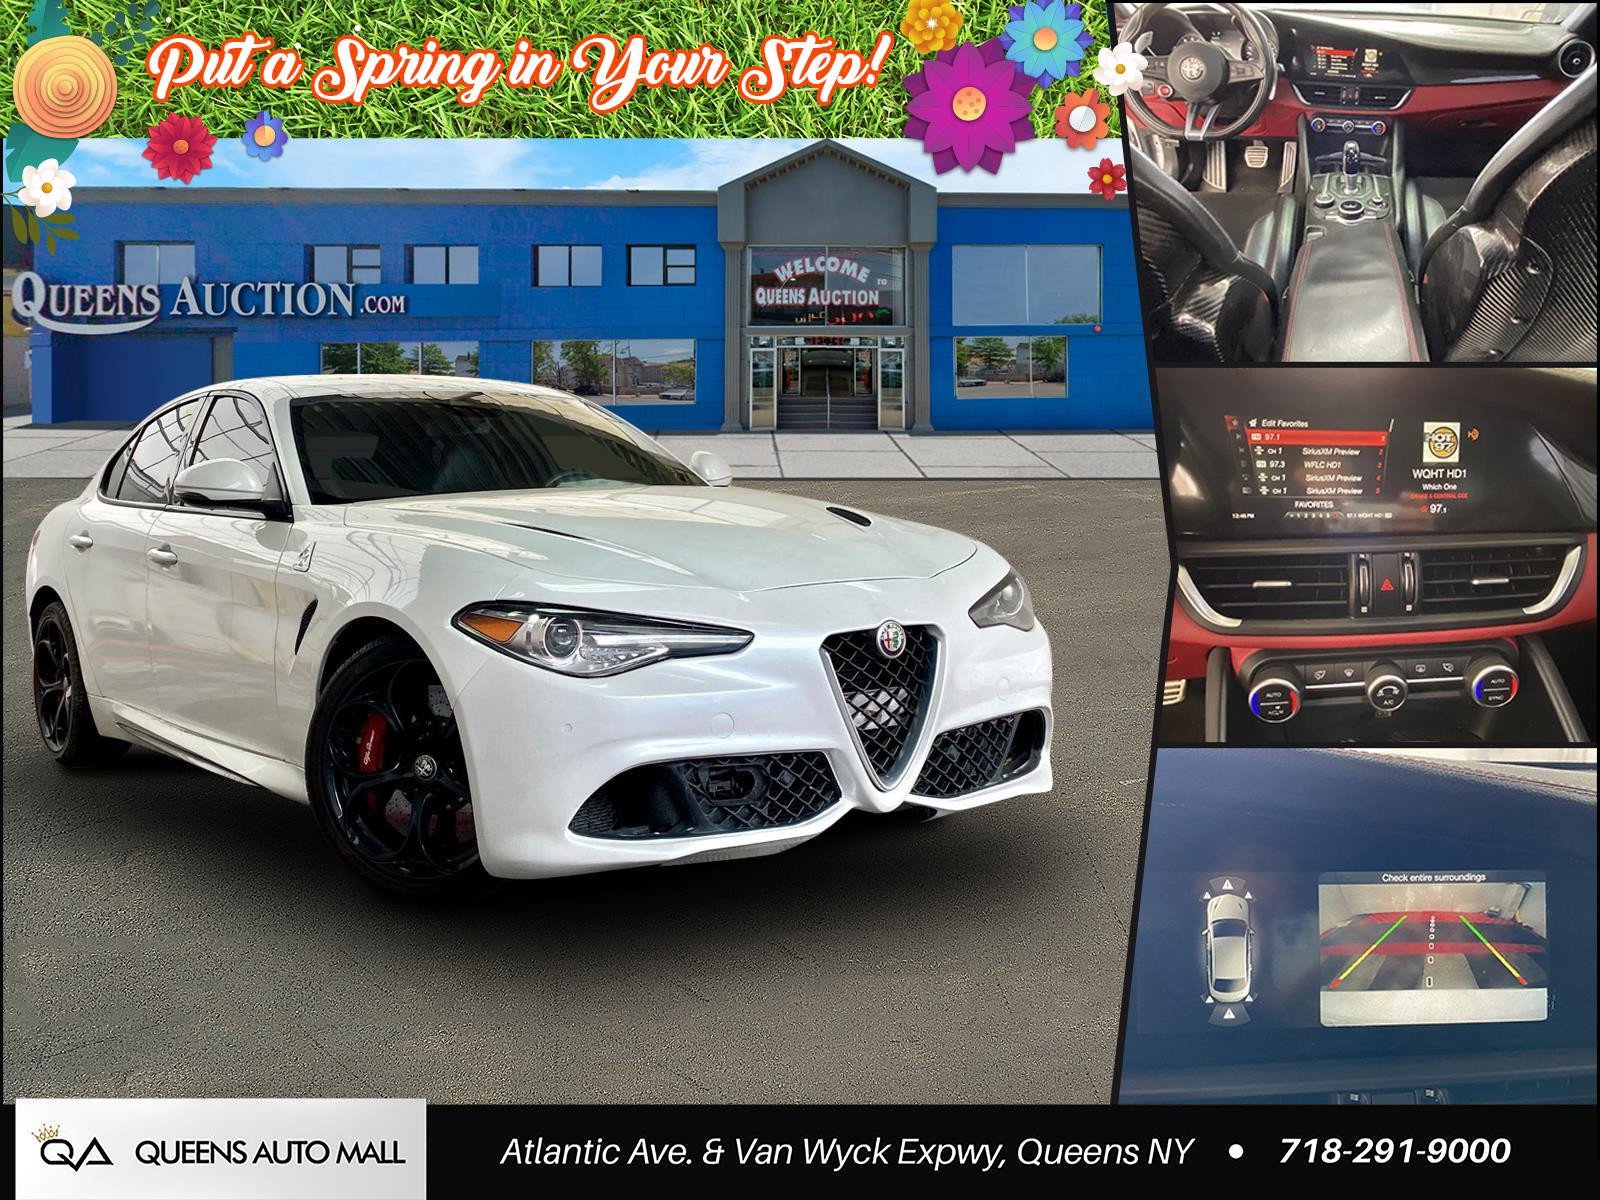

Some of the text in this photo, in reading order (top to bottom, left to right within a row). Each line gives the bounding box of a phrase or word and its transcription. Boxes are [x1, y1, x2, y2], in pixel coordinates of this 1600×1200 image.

[774, 256, 871, 284] WELCOME
[755, 286, 879, 307] QUEENS AUCTION
[12, 271, 406, 335] QUEENS AUCTION .COM
[1261, 418, 1309, 429] Edit Favorites
[1264, 433, 1281, 441] 97.1
[1302, 447, 1333, 456] SiriusXM
[1334, 448, 1361, 456] Preview
[1269, 460, 1286, 469] 97.3
[1304, 461, 1325, 469] WFLC
[1326, 461, 1342, 469] HD1
[1412, 468, 1467, 479] WQHT HD1
[1305, 474, 1335, 483] SiriusXM
[1336, 474, 1363, 482] Preview
[1306, 487, 1336, 495] SiriusXM
[1337, 487, 1363, 495] Preview
[1422, 483, 1458, 491] Which One
[1294, 500, 1334, 509] FAVORITES
[1382, 872, 1487, 883] Check entire surroundings
